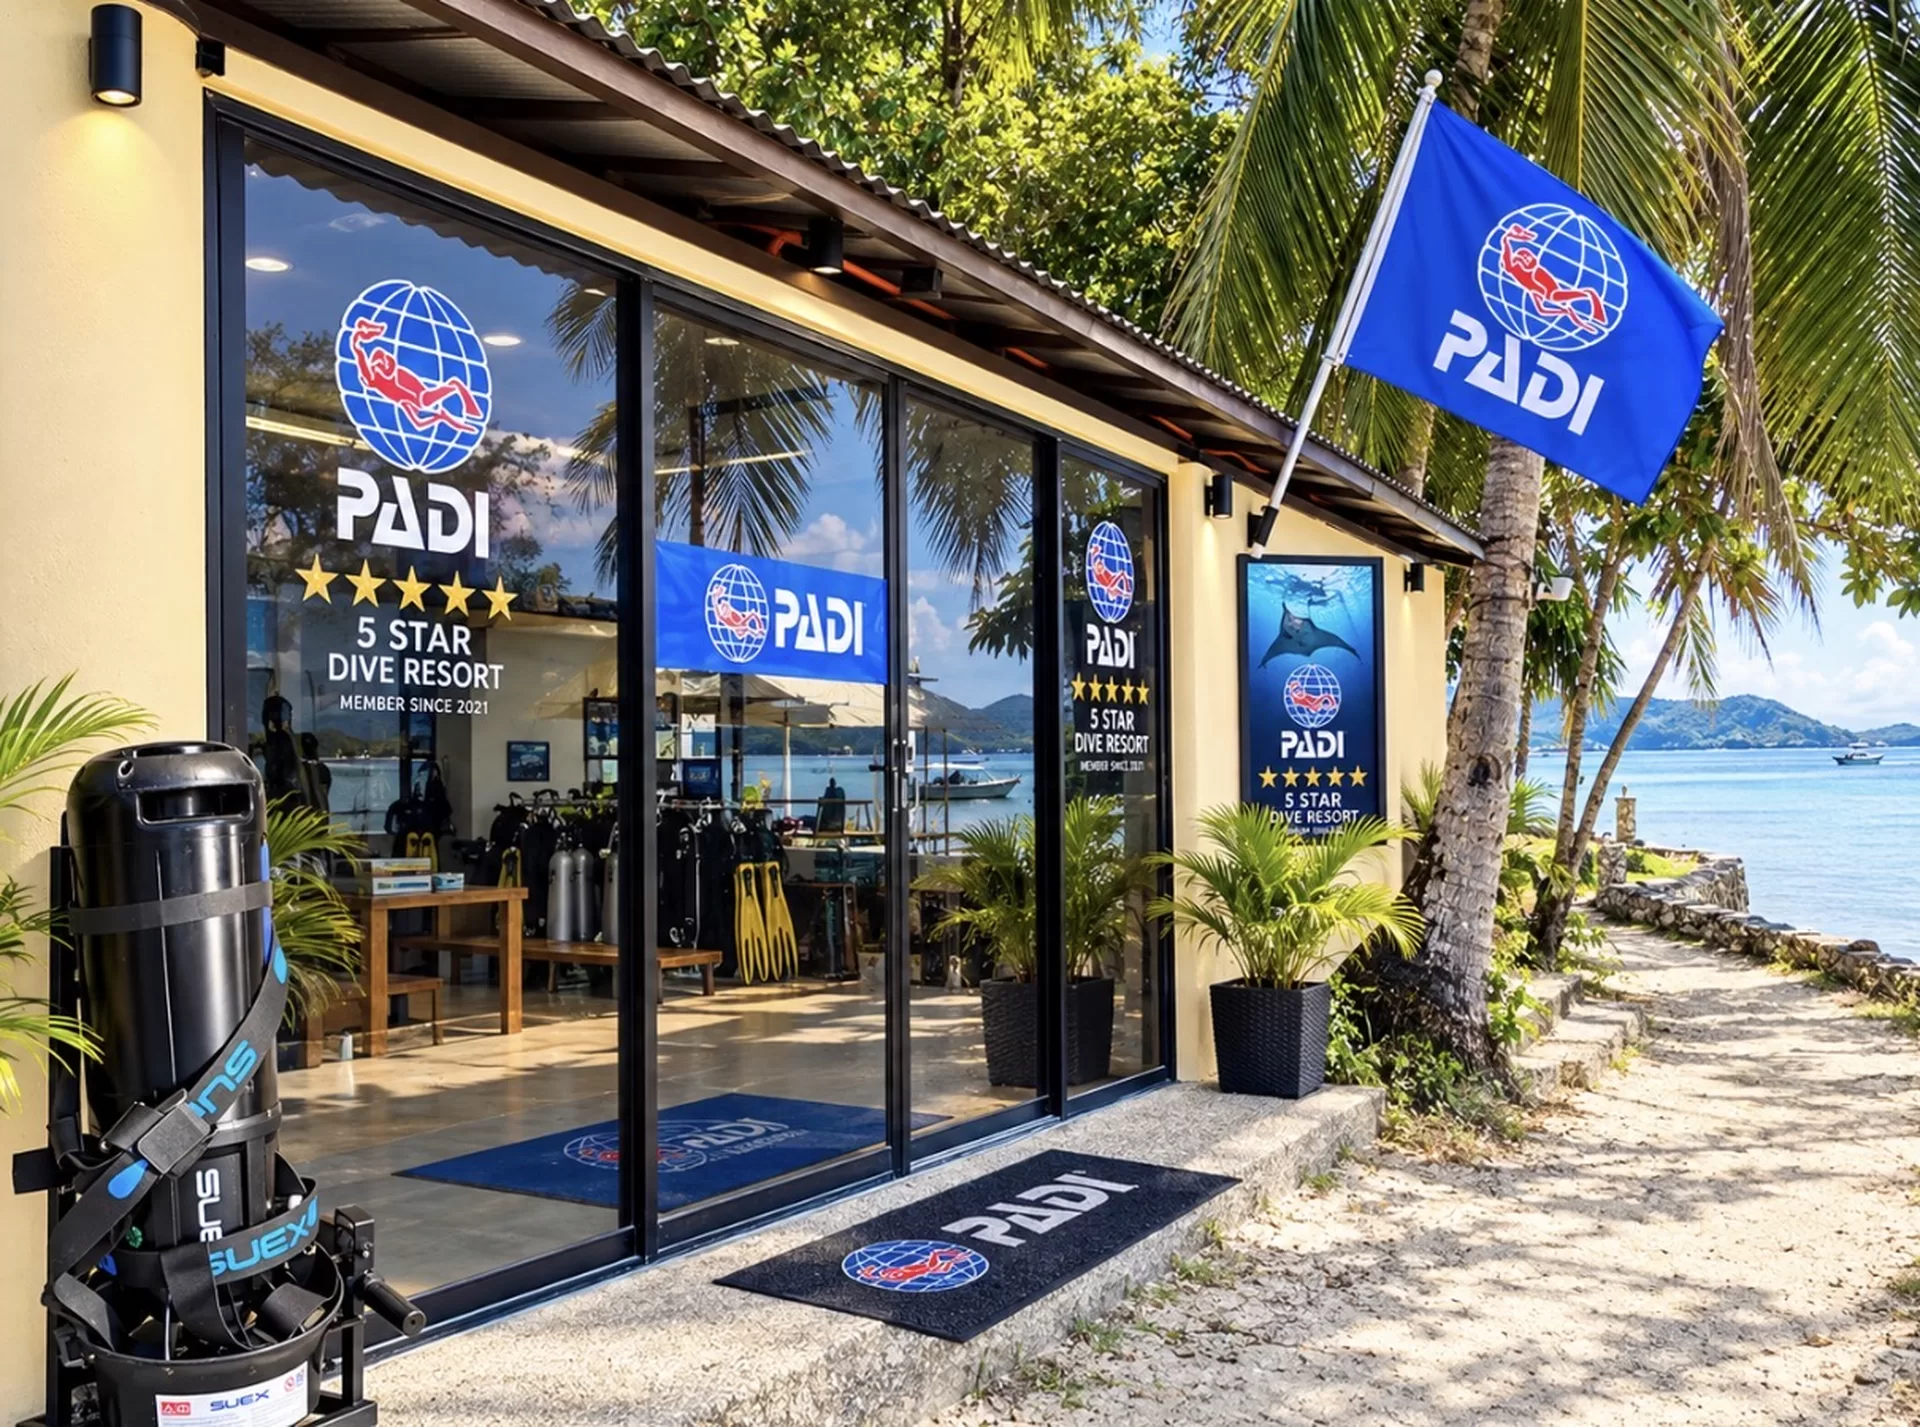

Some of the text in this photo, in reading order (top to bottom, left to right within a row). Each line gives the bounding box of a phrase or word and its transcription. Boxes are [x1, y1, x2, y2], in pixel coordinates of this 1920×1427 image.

[1433, 309, 1604, 437] PADI
[337, 466, 490, 559] PADI
[356, 616, 472, 656] 5 STAR
[774, 587, 864, 657] PADI
[1086, 623, 1136, 670] PADI
[328, 652, 504, 690] DIVE RESORT
[340, 694, 489, 715] MEMBER SINCE 2021
[1090, 707, 1135, 732] 5 STAR
[1074, 732, 1150, 754] DIVE RESORT
[1280, 730, 1345, 759] PADI
[1270, 809, 1360, 824] DIVE RESORT
[1299, 791, 1342, 809] STAR
[940, 1173, 1140, 1248] PADI
[209, 1389, 270, 1412] SUEX
